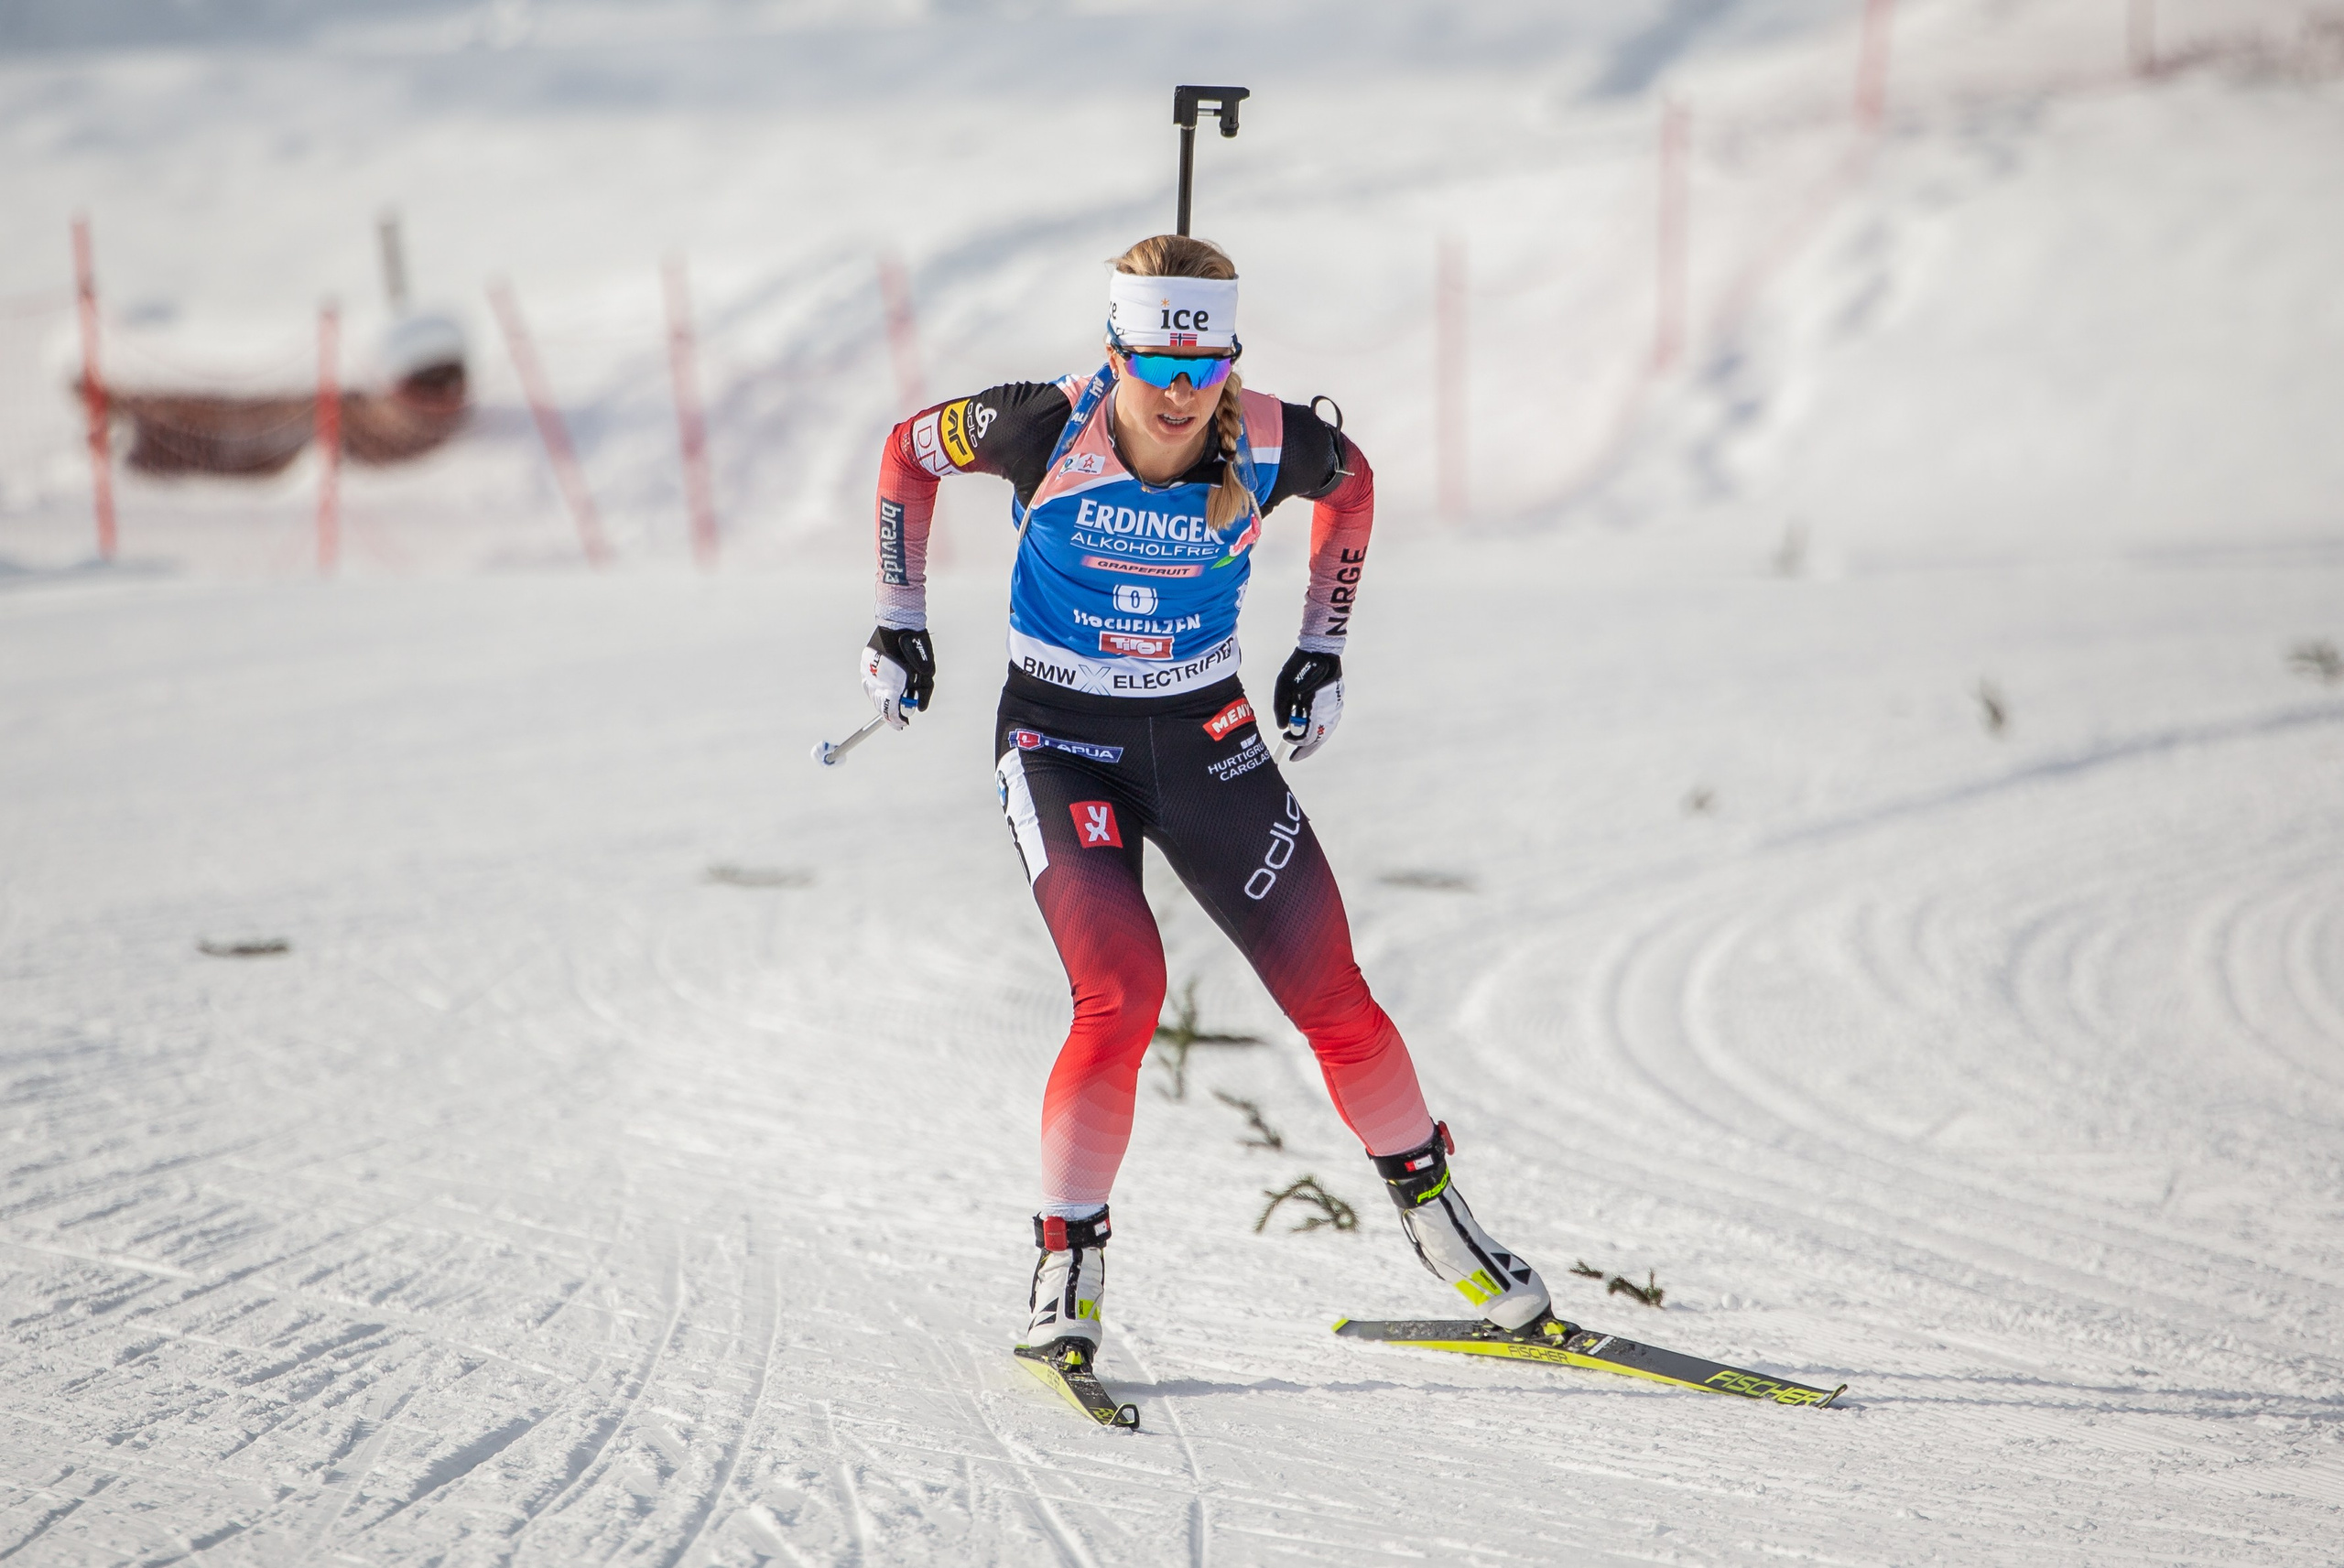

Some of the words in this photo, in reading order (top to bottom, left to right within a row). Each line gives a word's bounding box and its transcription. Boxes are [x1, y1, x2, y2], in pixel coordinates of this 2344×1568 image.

[1160, 298, 1210, 331] ice
[967, 402, 978, 448] odlo
[917, 425, 953, 476] DN
[881, 501, 904, 584] bravida
[1097, 561, 1191, 576] GRAPEFRUIT
[1024, 655, 1077, 686] BMW
[1211, 703, 1252, 733] MENY
[1243, 791, 1300, 900] odlo
[1508, 1346, 1569, 1364] FISCHER
[1705, 1370, 1825, 1407] FISCHER
